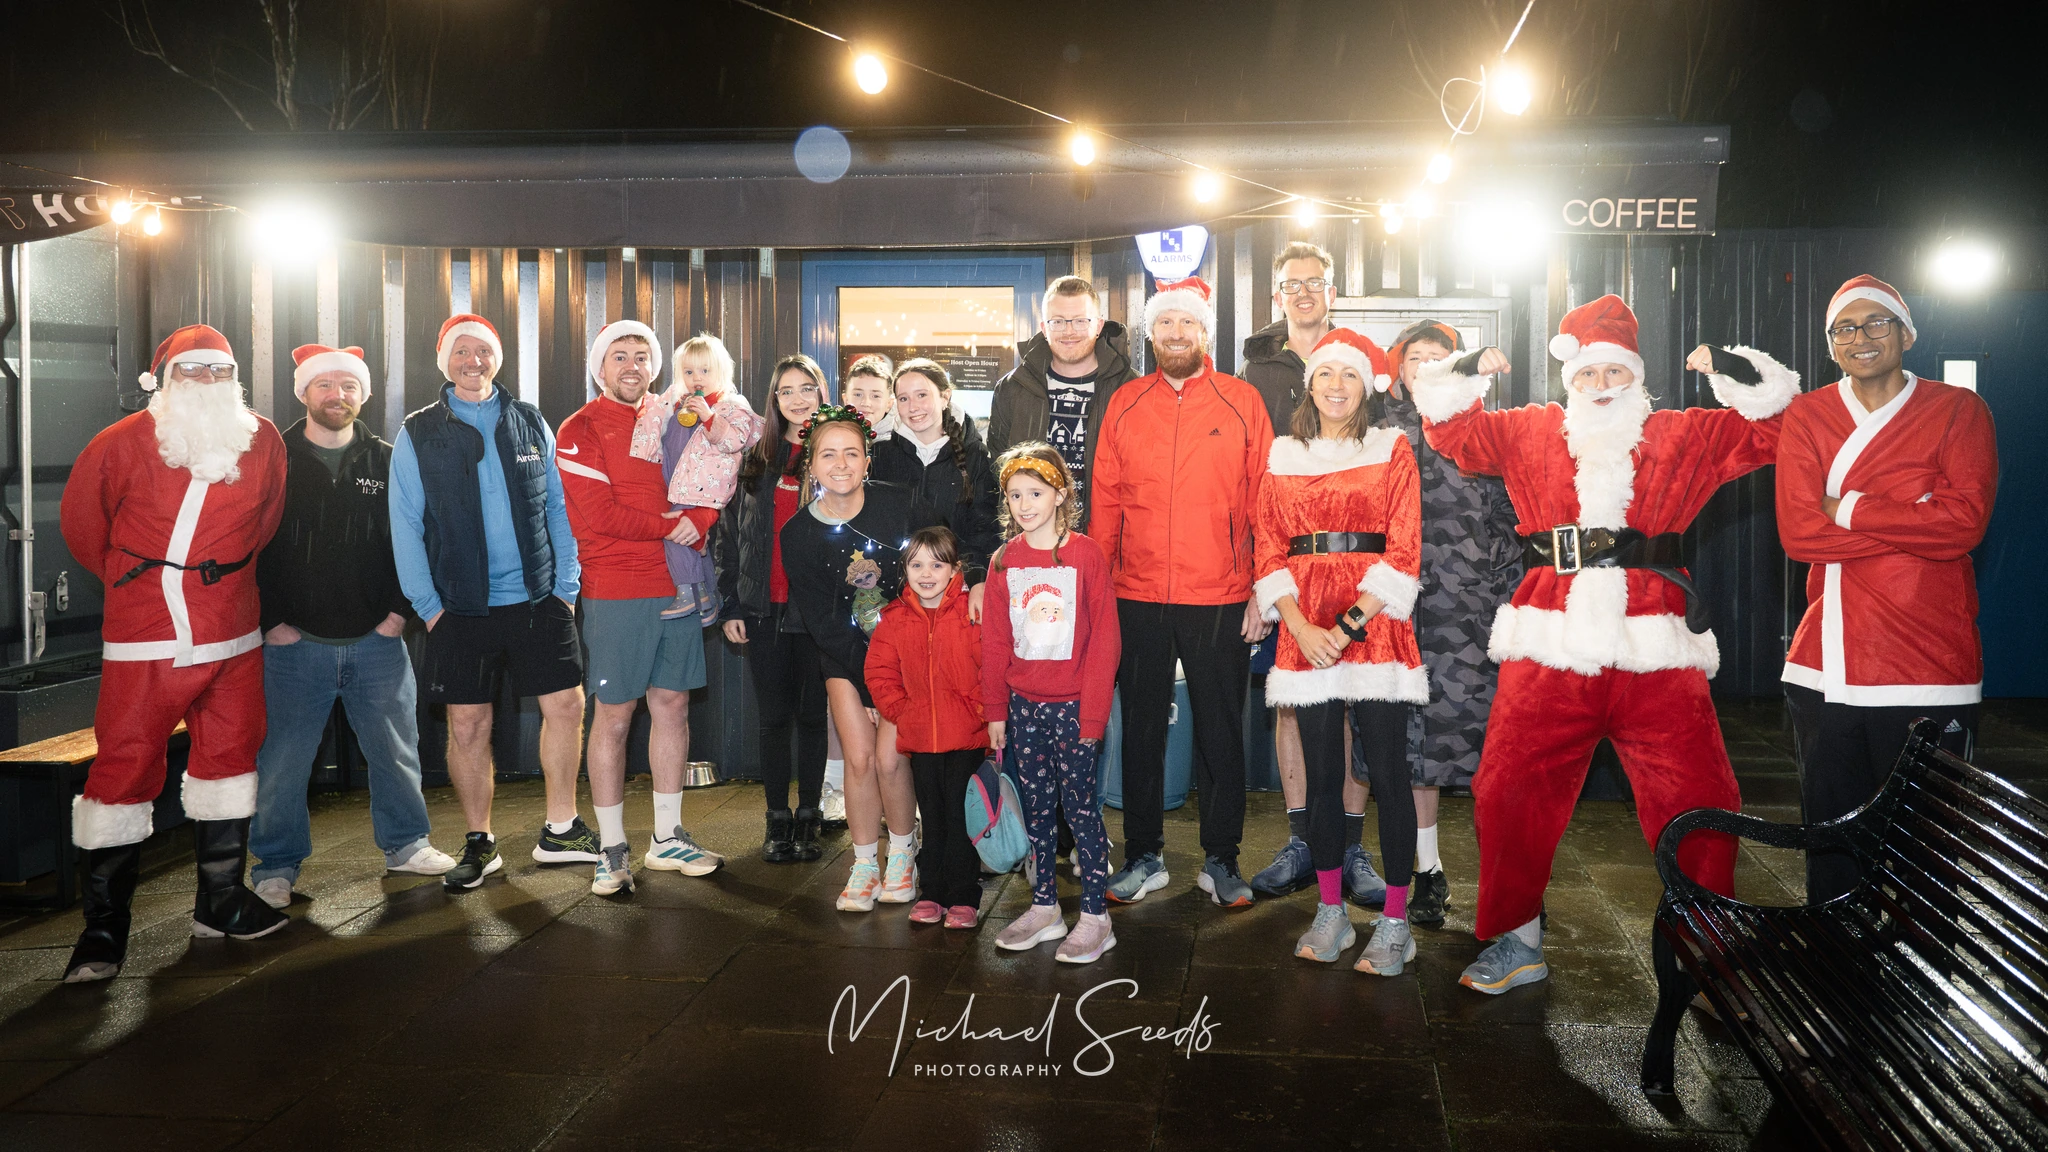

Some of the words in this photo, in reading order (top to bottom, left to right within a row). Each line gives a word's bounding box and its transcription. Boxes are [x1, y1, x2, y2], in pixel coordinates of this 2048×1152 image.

[1562, 198, 1698, 228] COFFEE
[1150, 254, 1193, 263] ALARMS
[356, 477, 385, 489] MADE
